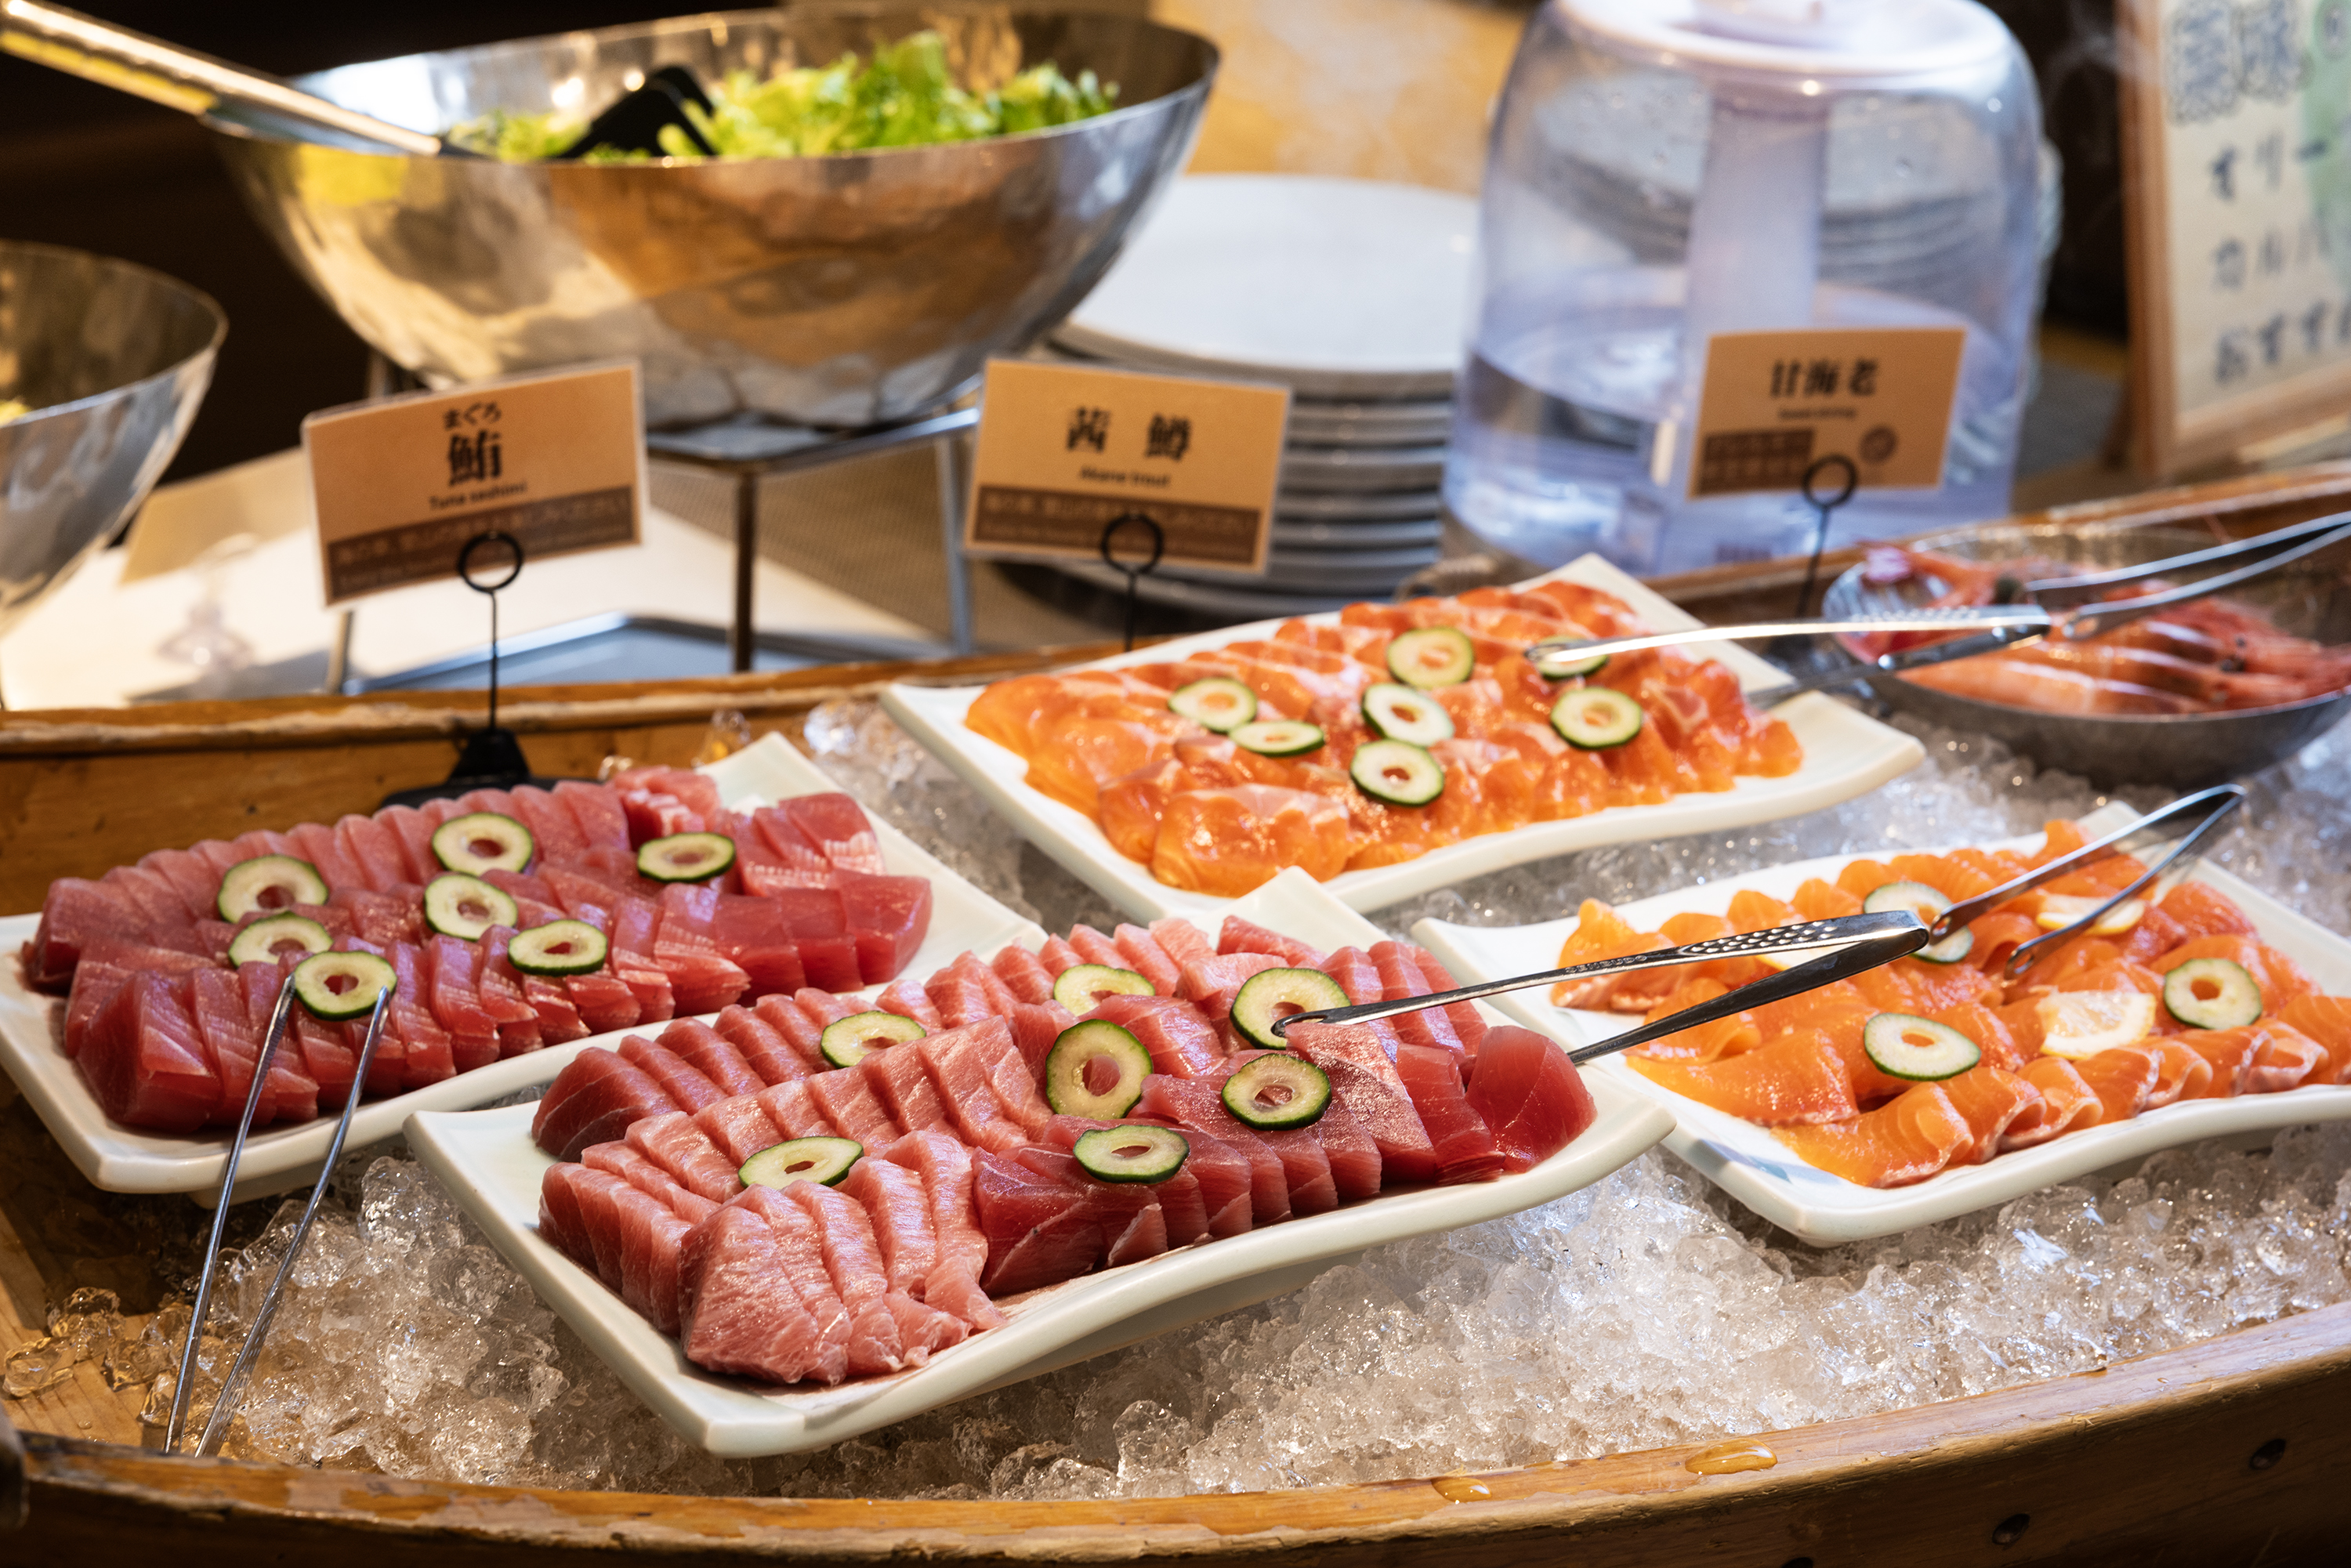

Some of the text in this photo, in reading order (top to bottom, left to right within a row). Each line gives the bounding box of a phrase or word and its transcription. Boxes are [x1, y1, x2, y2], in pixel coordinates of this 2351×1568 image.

[1770, 359, 1878, 397] 甘海老
[443, 400, 502, 431] まぐろ
[448, 429, 502, 487] 鮪
[429, 490, 465, 510] Tuna
